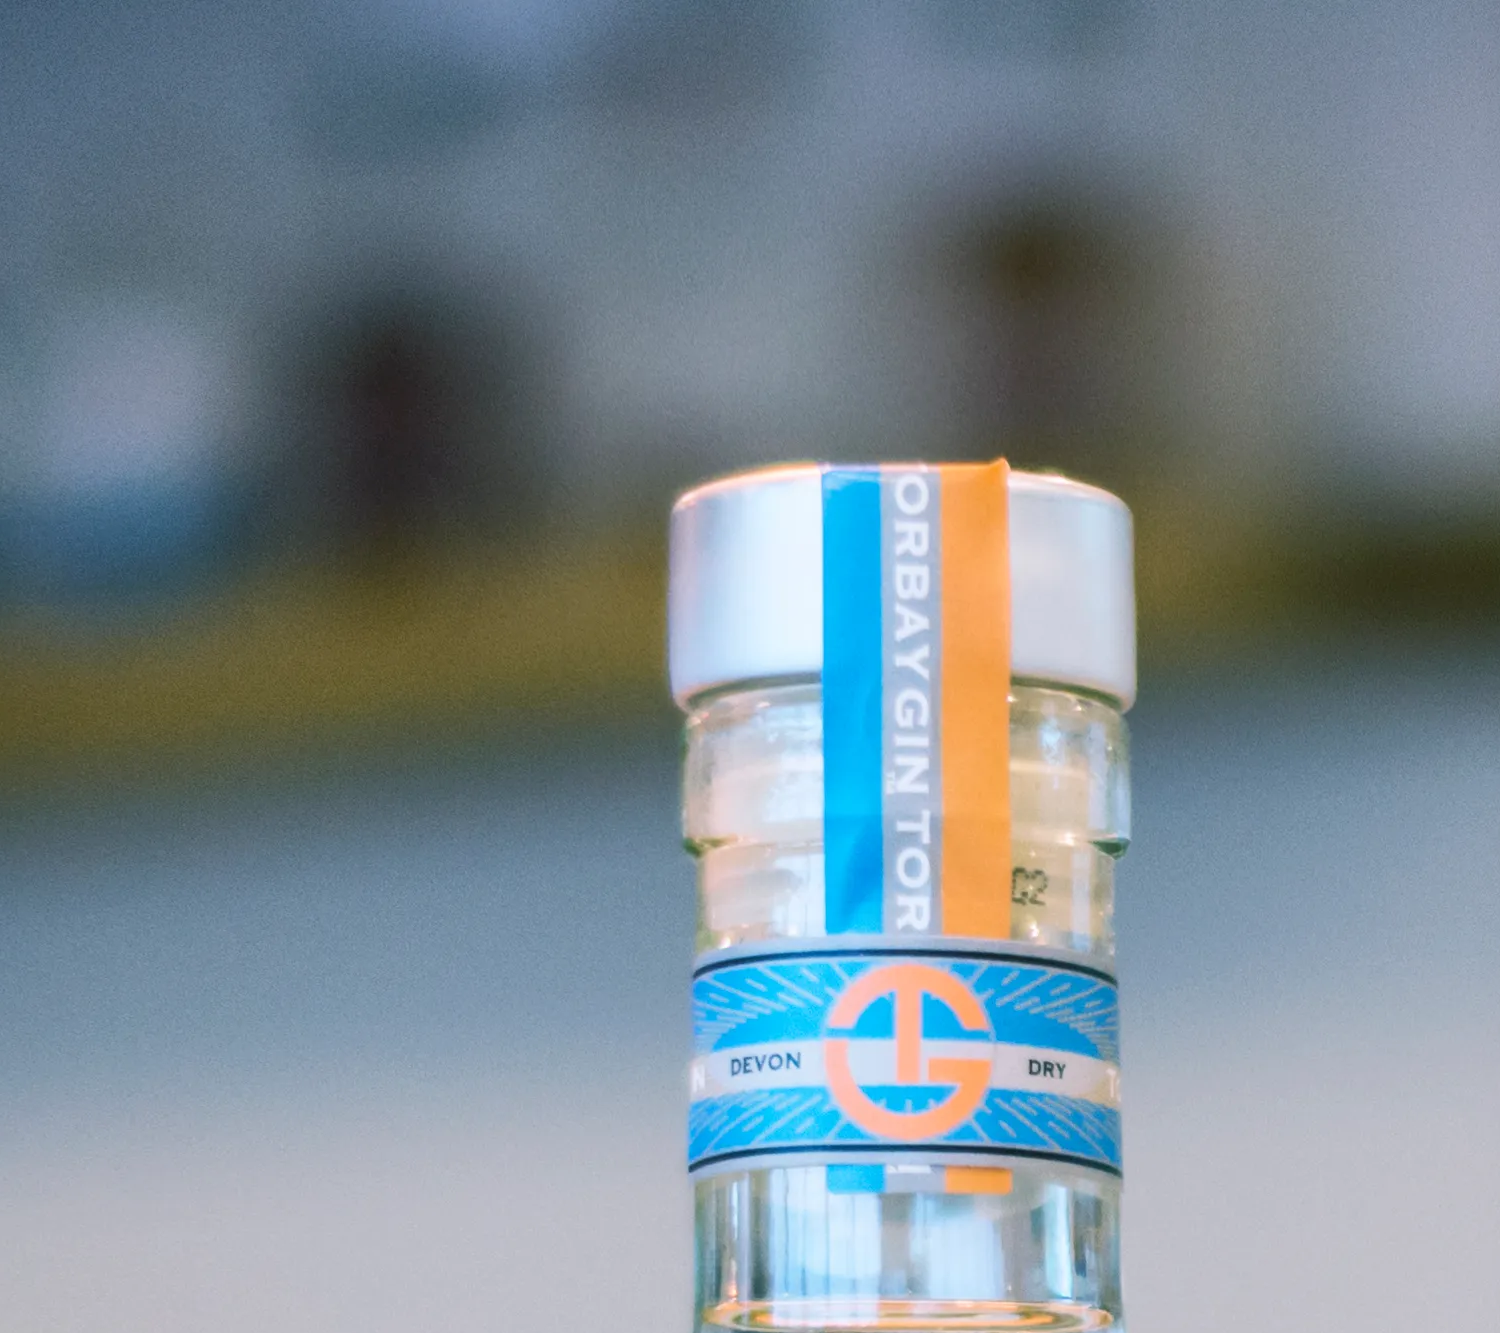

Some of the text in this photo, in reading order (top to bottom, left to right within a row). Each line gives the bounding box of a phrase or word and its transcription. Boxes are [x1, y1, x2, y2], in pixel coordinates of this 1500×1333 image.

[894, 688, 931, 794] GIN
[730, 1051, 801, 1077] DEVON
[1028, 1058, 1066, 1079] DRY
